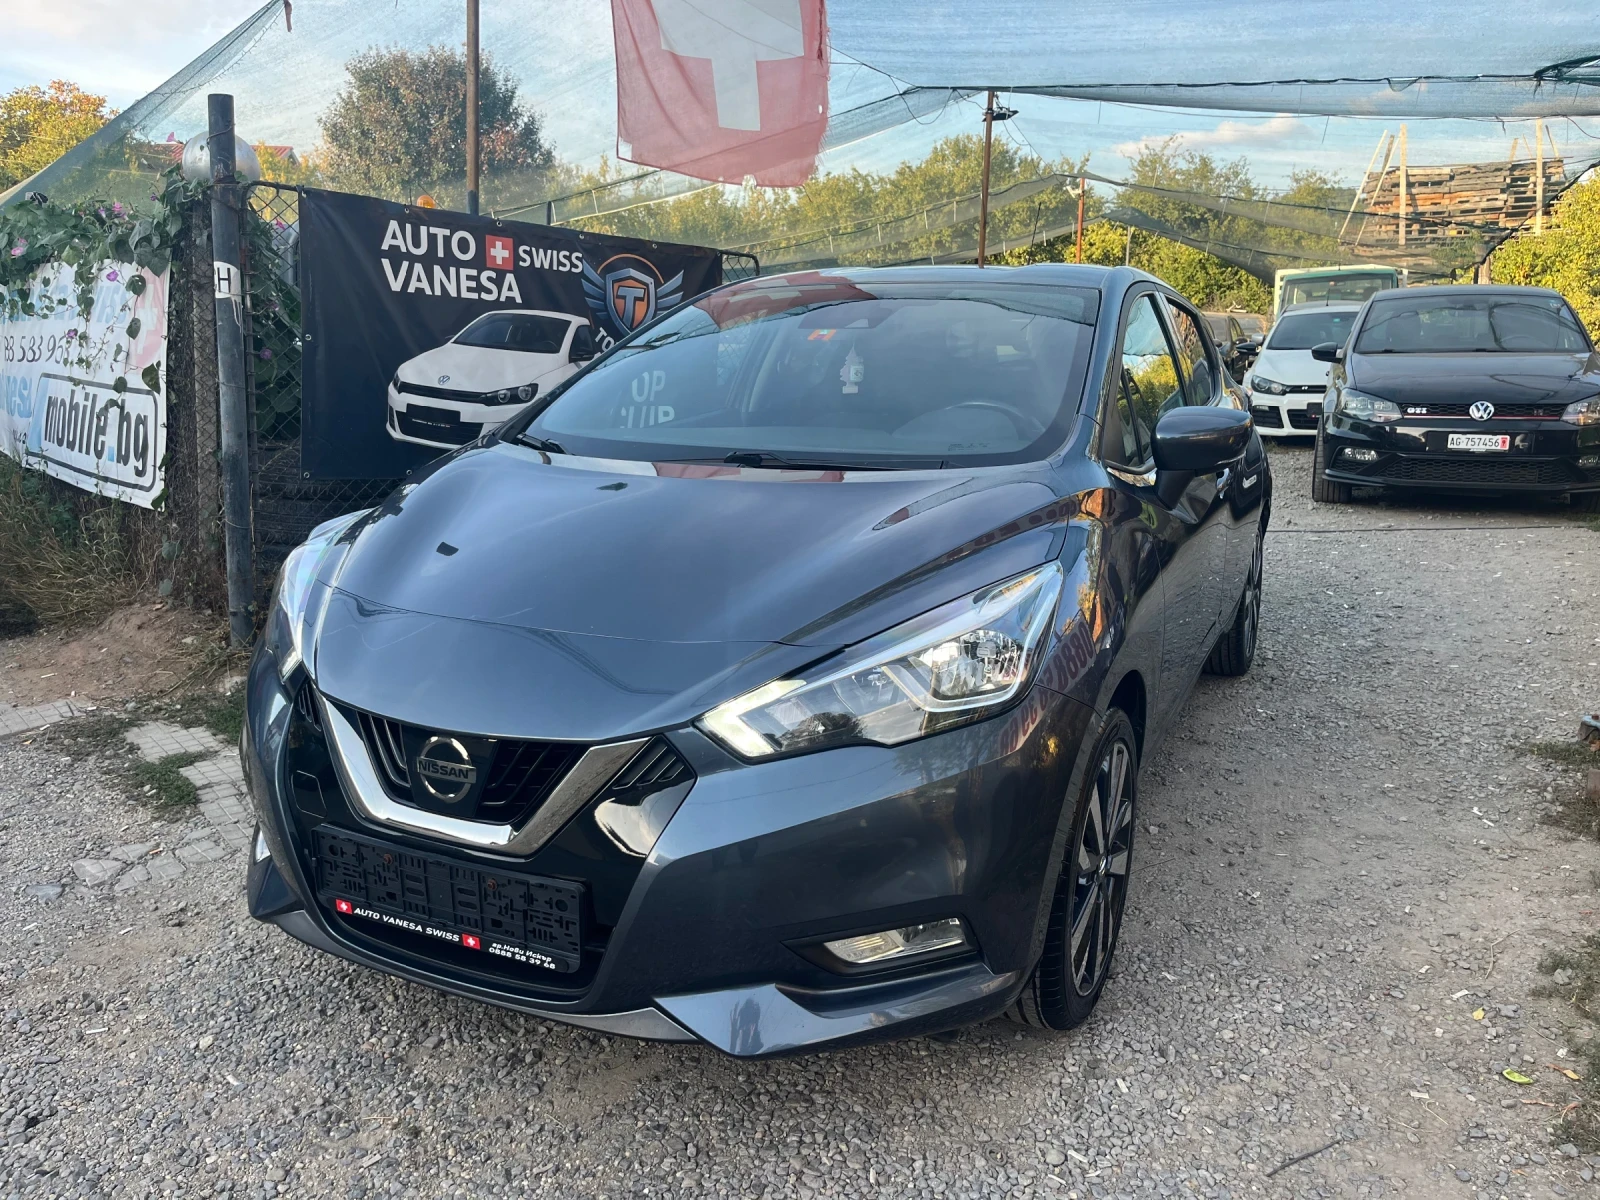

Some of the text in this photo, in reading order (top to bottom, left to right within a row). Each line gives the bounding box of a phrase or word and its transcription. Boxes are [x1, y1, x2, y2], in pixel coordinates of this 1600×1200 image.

[380, 219, 584, 274] AUTO SWISS
[381, 258, 523, 304] VANESA
[44, 388, 150, 479] mobile.bg
[418, 759, 470, 780] NISSAN
[354, 907, 460, 943] AUTO VANESA SWISS
